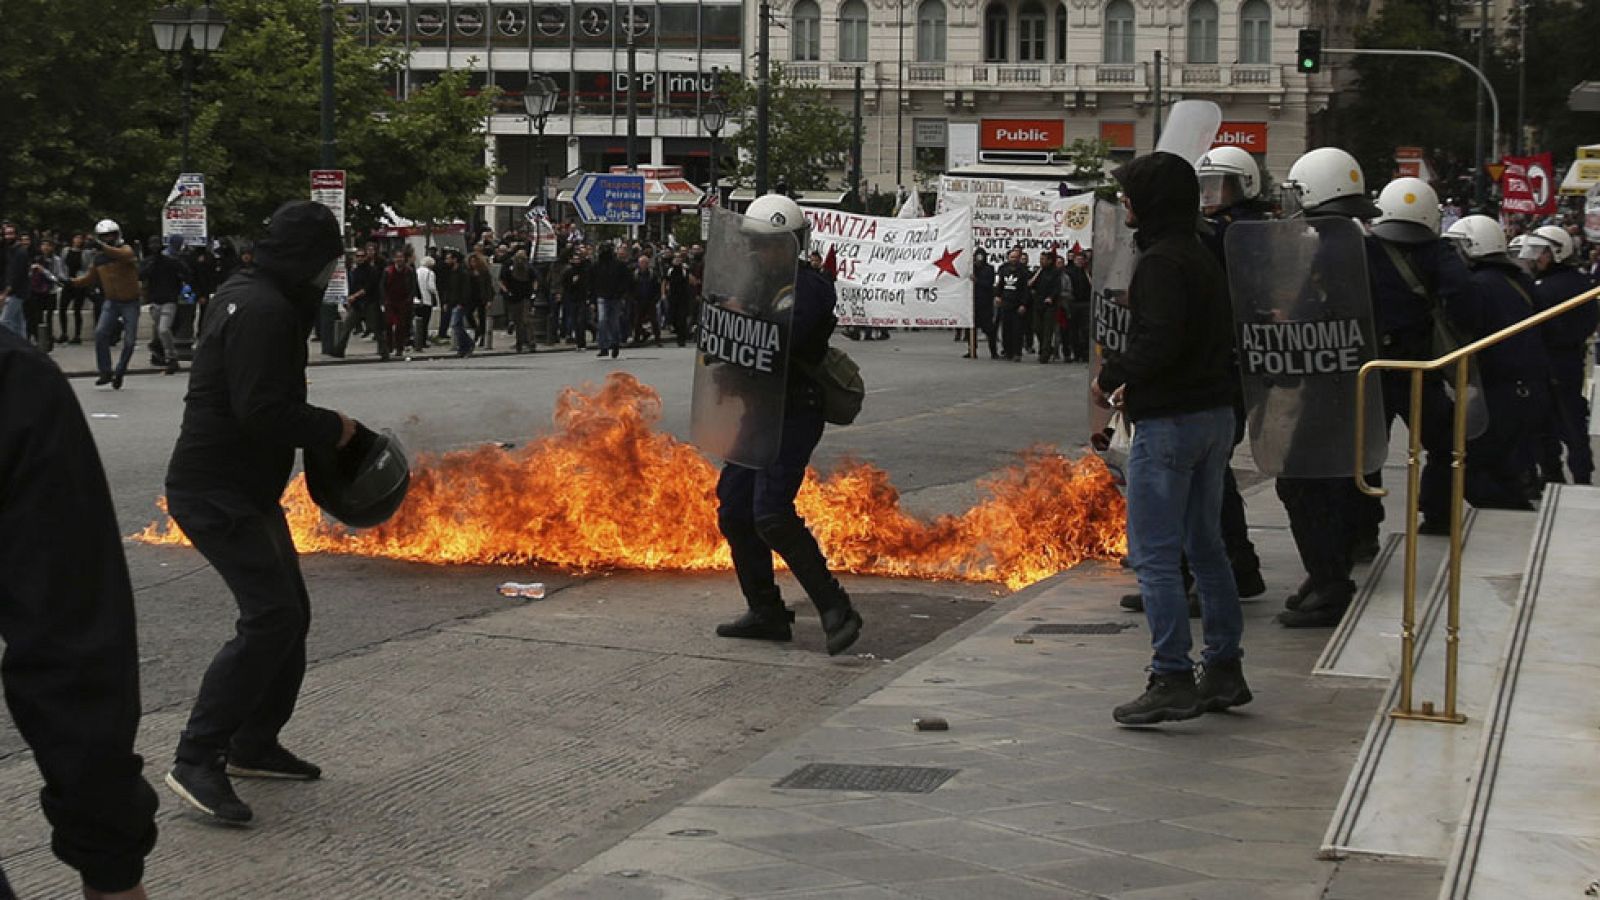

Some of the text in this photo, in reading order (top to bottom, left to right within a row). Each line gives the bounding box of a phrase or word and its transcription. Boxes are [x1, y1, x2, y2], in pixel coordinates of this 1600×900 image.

[995, 128, 1049, 141] Public
[605, 190, 641, 199] Peiraias
[1243, 319, 1365, 351] ΑΣΤΥΝΟΜΙΑ
[1248, 348, 1361, 375] POLICE
